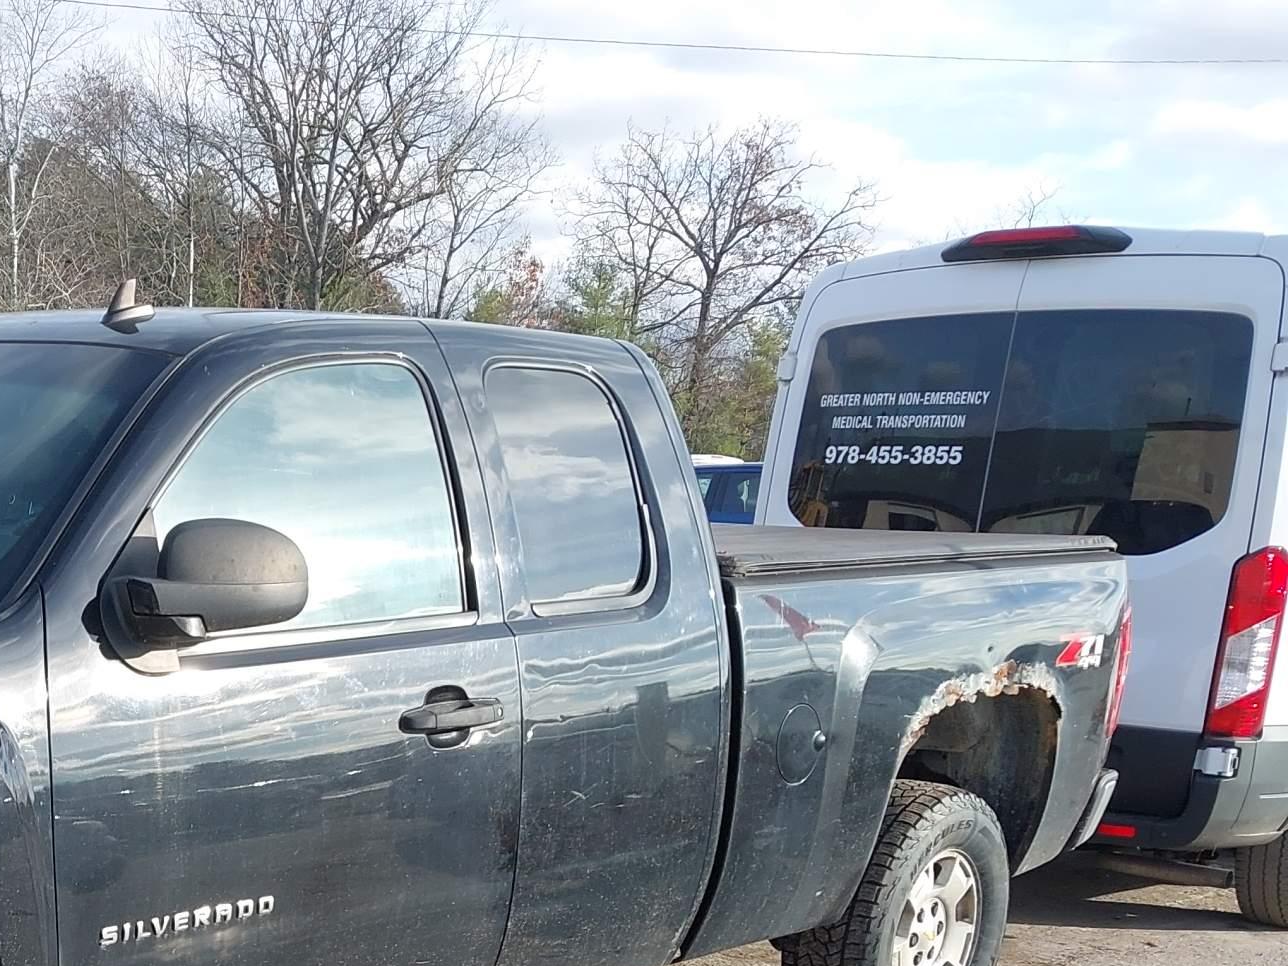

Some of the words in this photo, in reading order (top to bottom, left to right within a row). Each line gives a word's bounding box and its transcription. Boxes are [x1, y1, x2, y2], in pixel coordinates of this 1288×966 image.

[820, 392, 861, 408] GREATER
[862, 392, 896, 407] NORTH
[898, 390, 991, 406] NON-EMERGENCY
[831, 415, 873, 429] MEDICAL
[876, 414, 967, 429] TRANSPORTATION
[824, 445, 964, 465] 978-455-3855
[1055, 631, 1105, 667] Z71
[98, 894, 275, 948] SILVERADO
